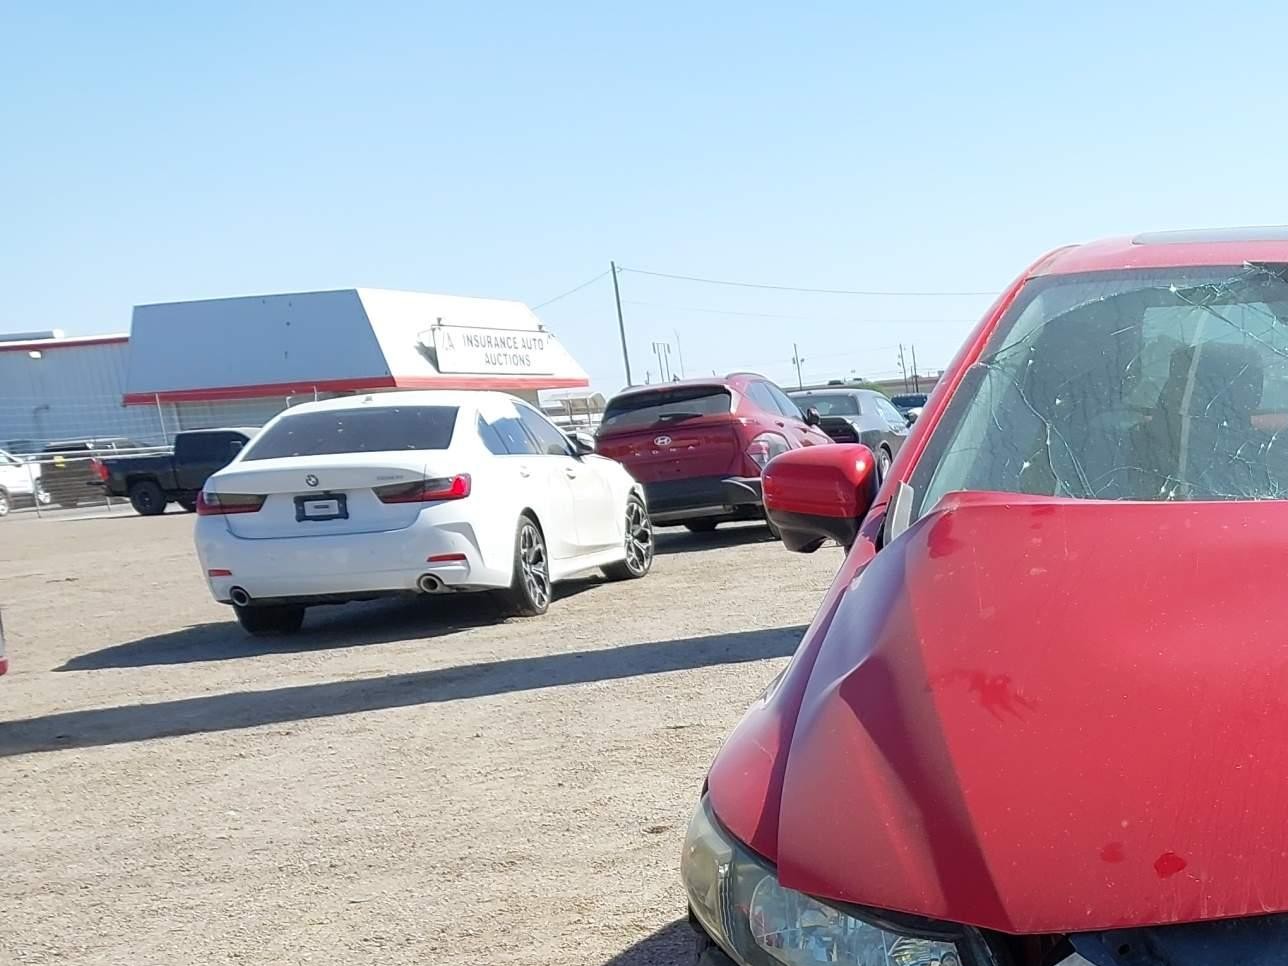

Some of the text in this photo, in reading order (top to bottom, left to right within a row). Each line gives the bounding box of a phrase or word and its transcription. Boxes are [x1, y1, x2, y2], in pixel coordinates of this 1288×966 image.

[461, 333, 519, 350] INSURANCE
[521, 337, 544, 351] AUTO
[484, 352, 531, 367] AUCTIONS
